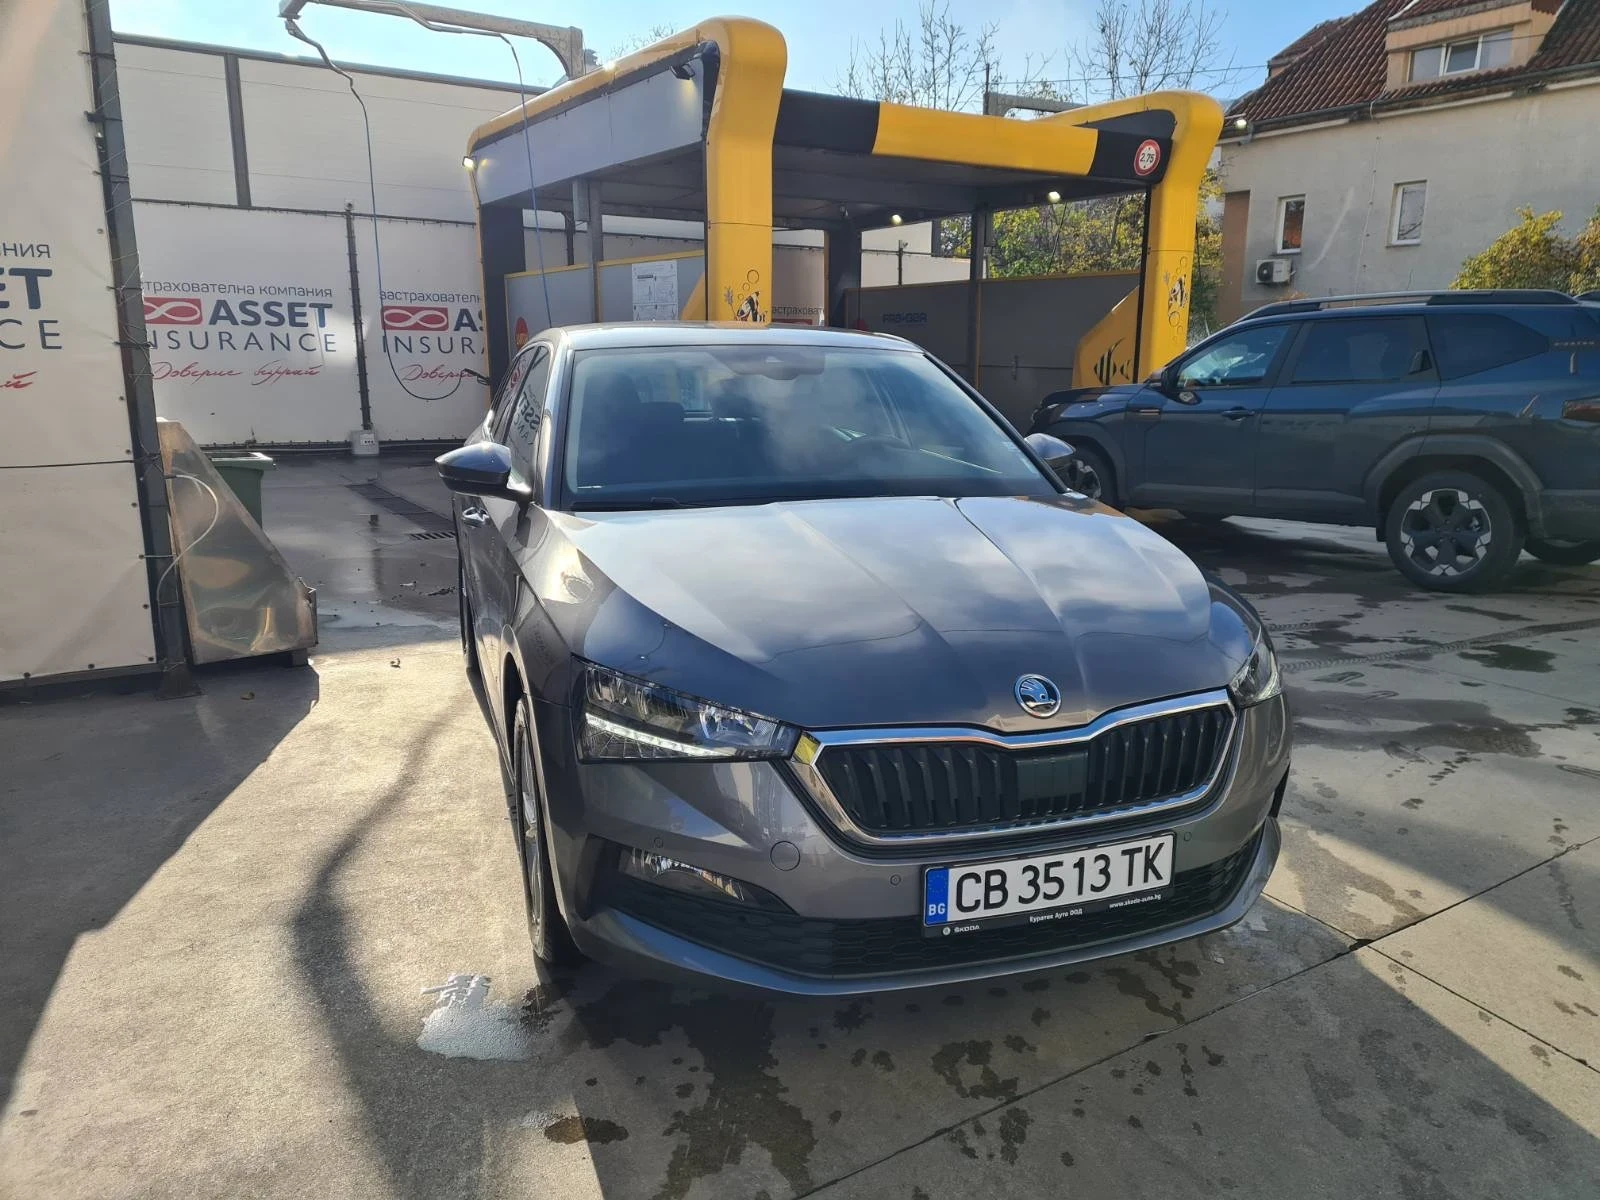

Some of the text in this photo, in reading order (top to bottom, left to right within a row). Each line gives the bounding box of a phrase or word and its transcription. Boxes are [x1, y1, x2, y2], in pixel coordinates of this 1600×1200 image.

[0, 242, 51, 259] ния
[259, 285, 333, 298] компания
[208, 299, 333, 328] ASSET
[453, 308, 483, 332] A
[382, 335, 485, 355] INSUR
[956, 842, 1165, 913] CB 3513 TK
[928, 903, 946, 916] BG
